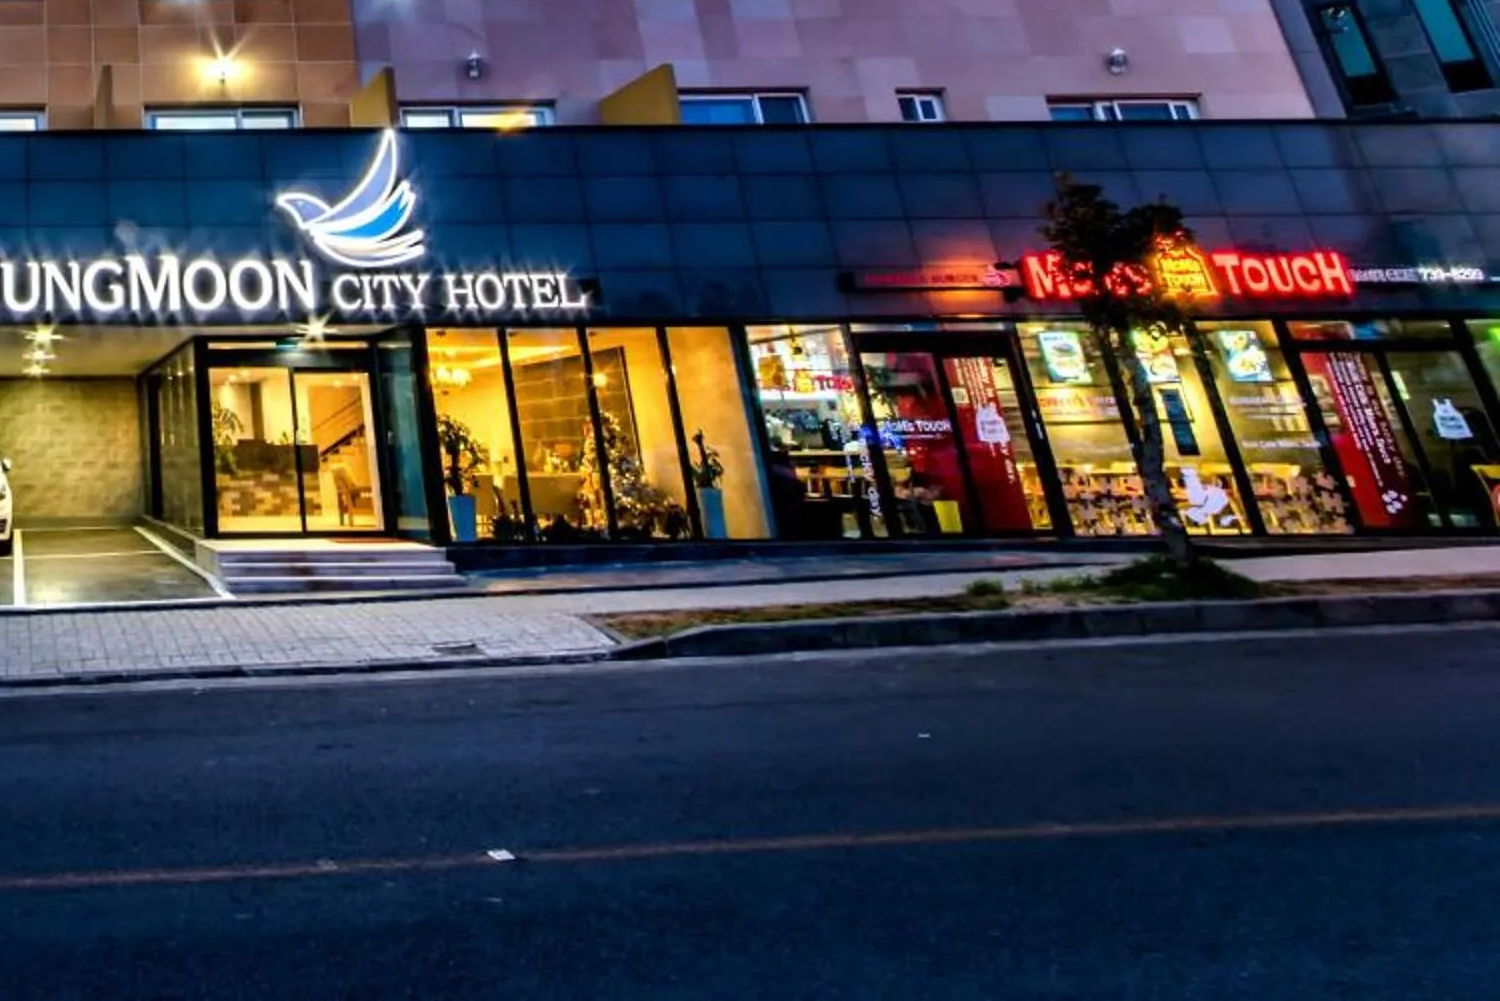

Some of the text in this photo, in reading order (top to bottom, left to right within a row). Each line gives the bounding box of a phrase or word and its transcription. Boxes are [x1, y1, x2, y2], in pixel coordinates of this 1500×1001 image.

[332, 273, 431, 312] CITY
[443, 271, 587, 311] HOTEL
[1210, 251, 1352, 296] TOUCH
